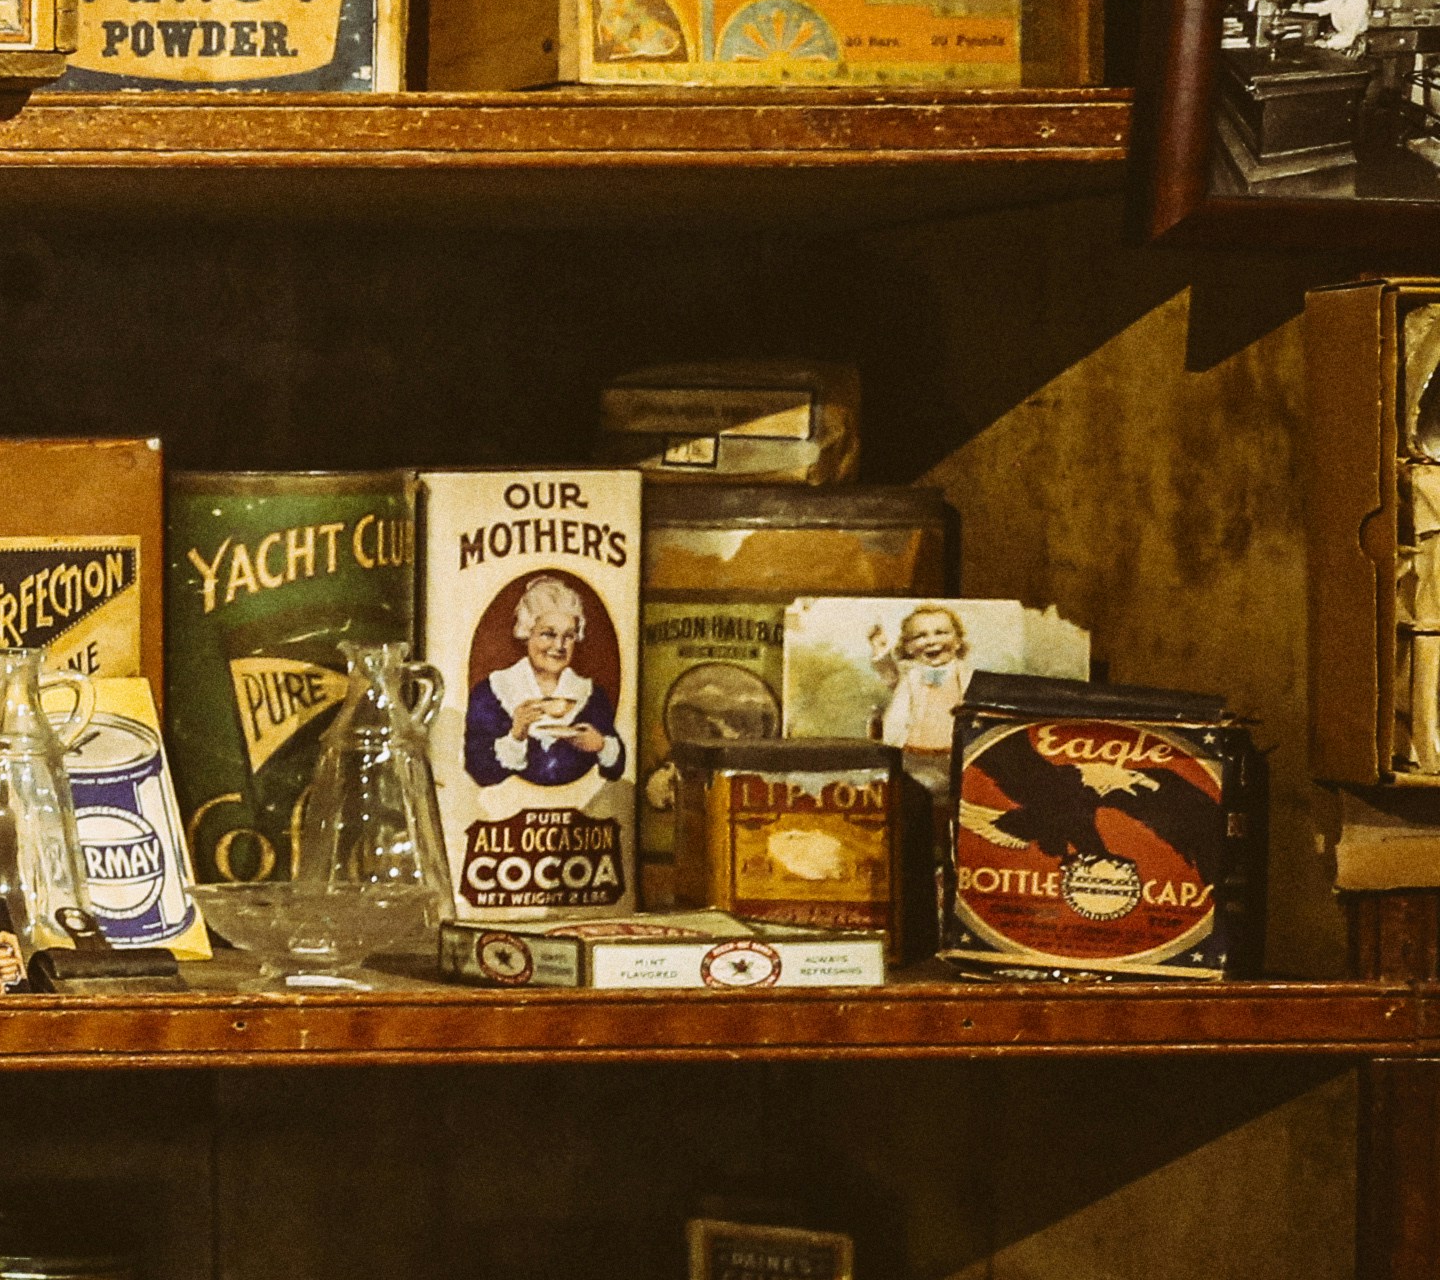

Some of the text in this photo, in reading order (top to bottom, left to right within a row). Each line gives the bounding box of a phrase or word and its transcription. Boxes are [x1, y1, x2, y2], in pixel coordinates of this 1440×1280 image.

[101, 21, 299, 60] POWDER.
[503, 483, 589, 511] OUR
[459, 519, 627, 570] MOTHER'S
[186, 521, 347, 614] YACHT
[241, 670, 331, 741] PURE
[1037, 724, 1176, 767] Eagle
[475, 825, 613, 851] ALL OCCASION
[526, 812, 572, 824] PURE
[466, 856, 620, 891] COCOA
[958, 864, 1216, 908] BOTTLE CAPS
